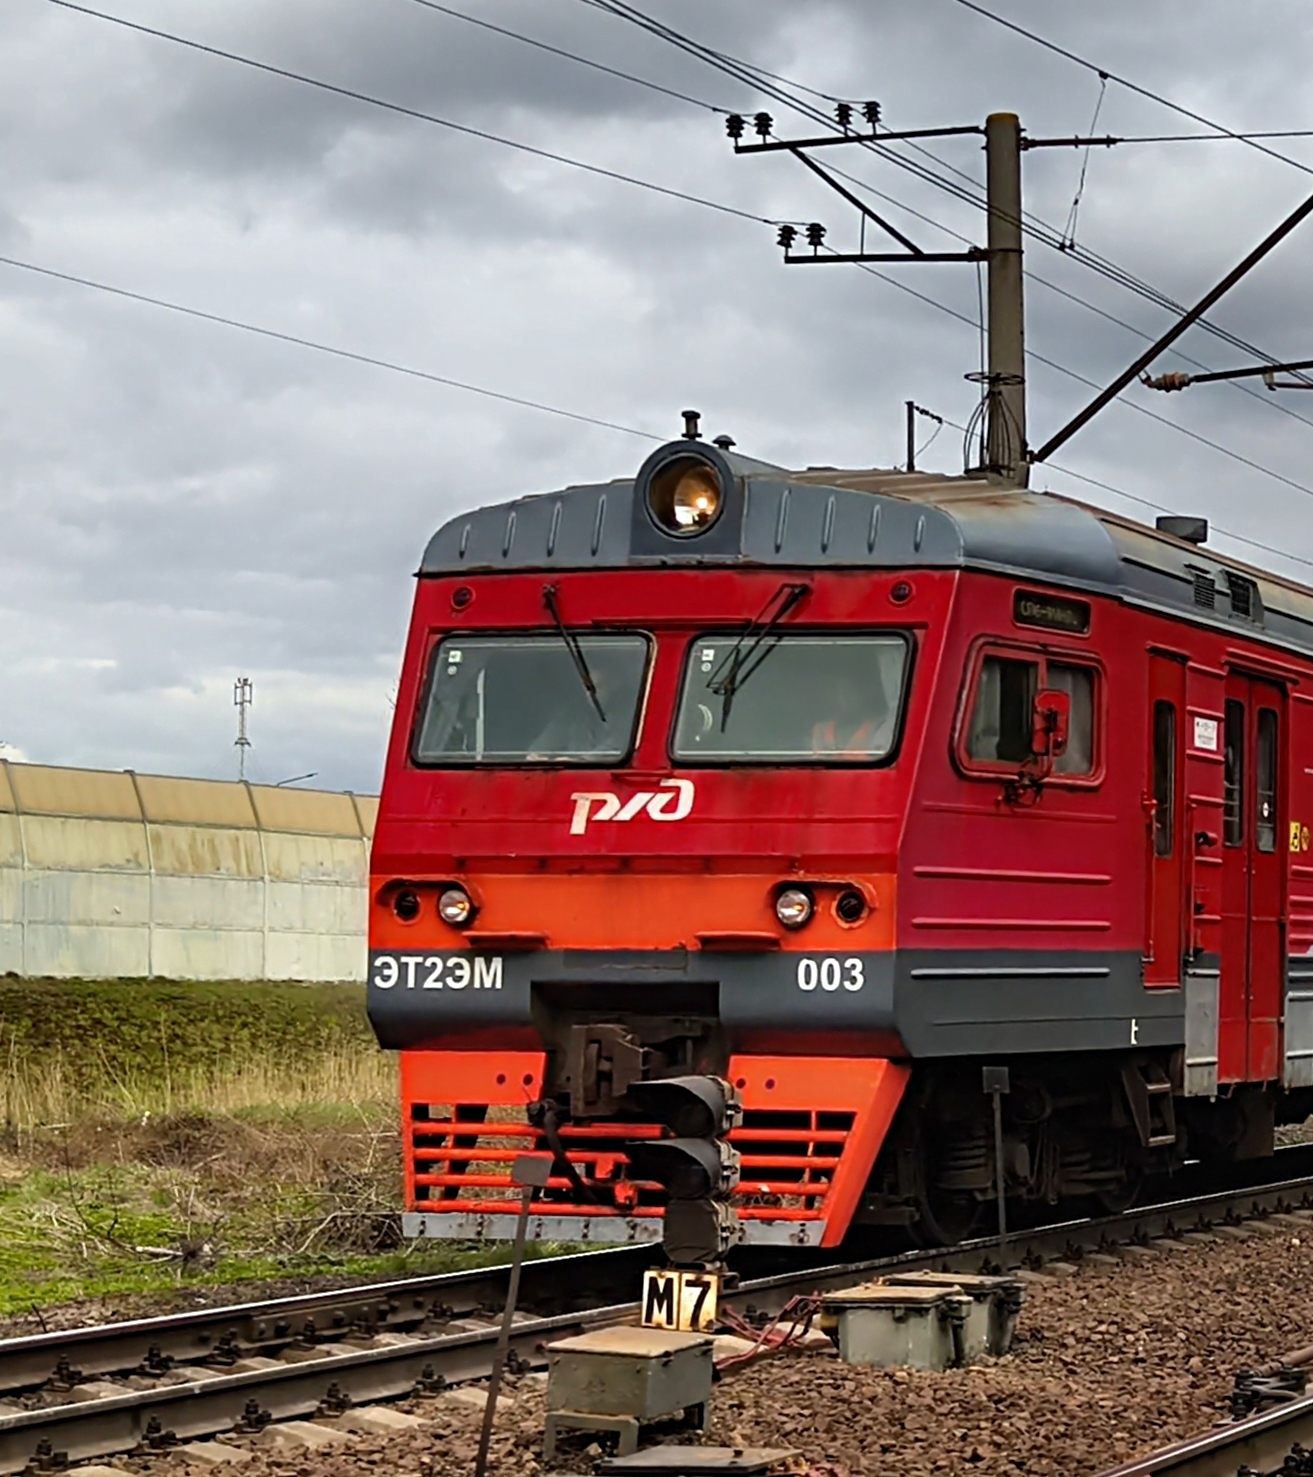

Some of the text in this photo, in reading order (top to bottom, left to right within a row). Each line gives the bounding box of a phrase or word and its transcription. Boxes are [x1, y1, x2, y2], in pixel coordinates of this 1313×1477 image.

[569, 777, 695, 836] РЖД
[373, 956, 504, 991] ЭТ2ЭМ
[796, 957, 865, 992] 003
